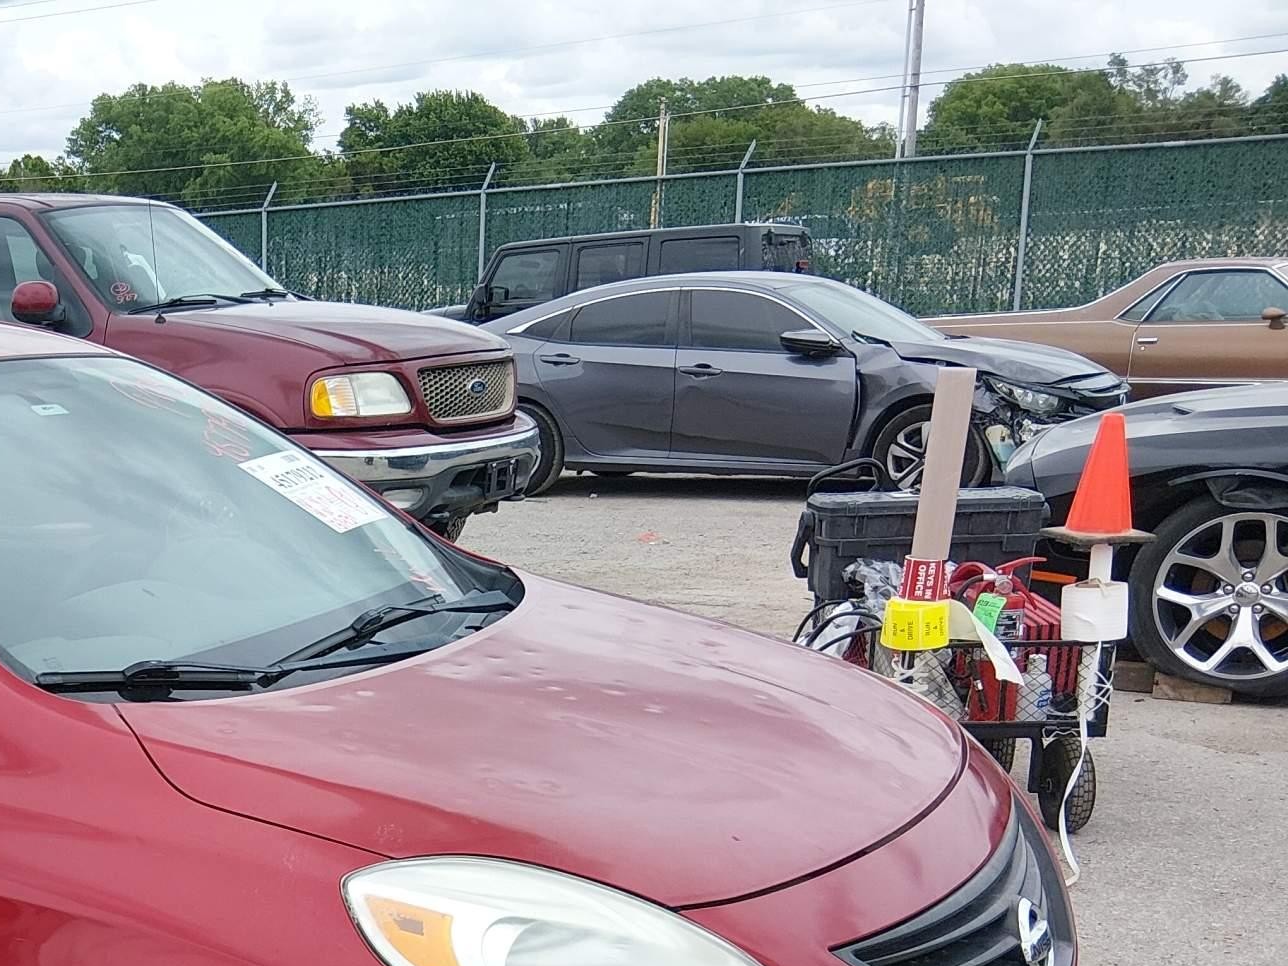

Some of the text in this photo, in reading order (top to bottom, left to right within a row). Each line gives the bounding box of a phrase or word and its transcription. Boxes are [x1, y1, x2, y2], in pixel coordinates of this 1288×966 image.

[271, 465, 325, 489] 45179212
[914, 565, 926, 596] OFFICE
[926, 563, 936, 587] KEYS
[924, 589, 932, 599] IN
